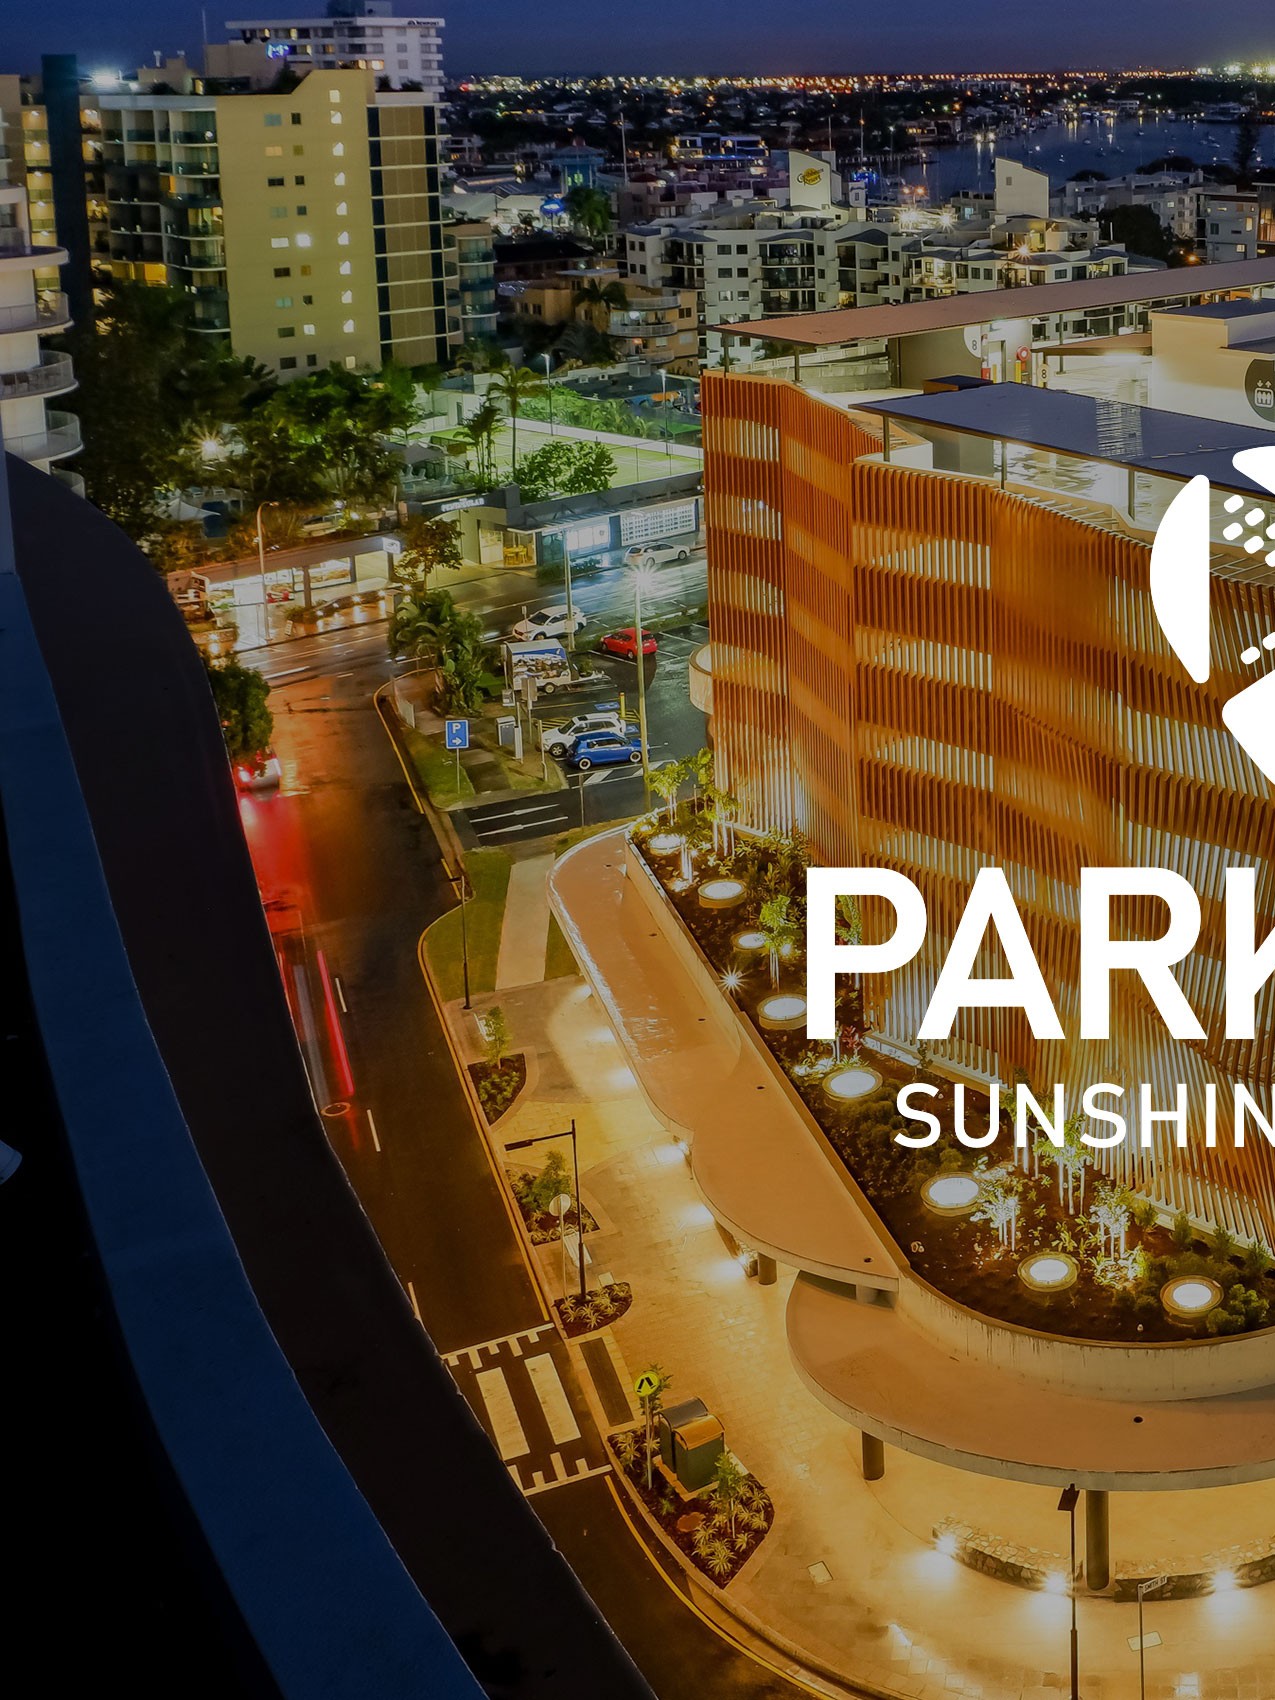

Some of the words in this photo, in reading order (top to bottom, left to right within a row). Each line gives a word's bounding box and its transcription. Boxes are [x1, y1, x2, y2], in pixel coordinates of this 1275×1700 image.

[972, 340, 978, 351] 8
[1041, 369, 1047, 379] 8
[452, 722, 462, 734] P
